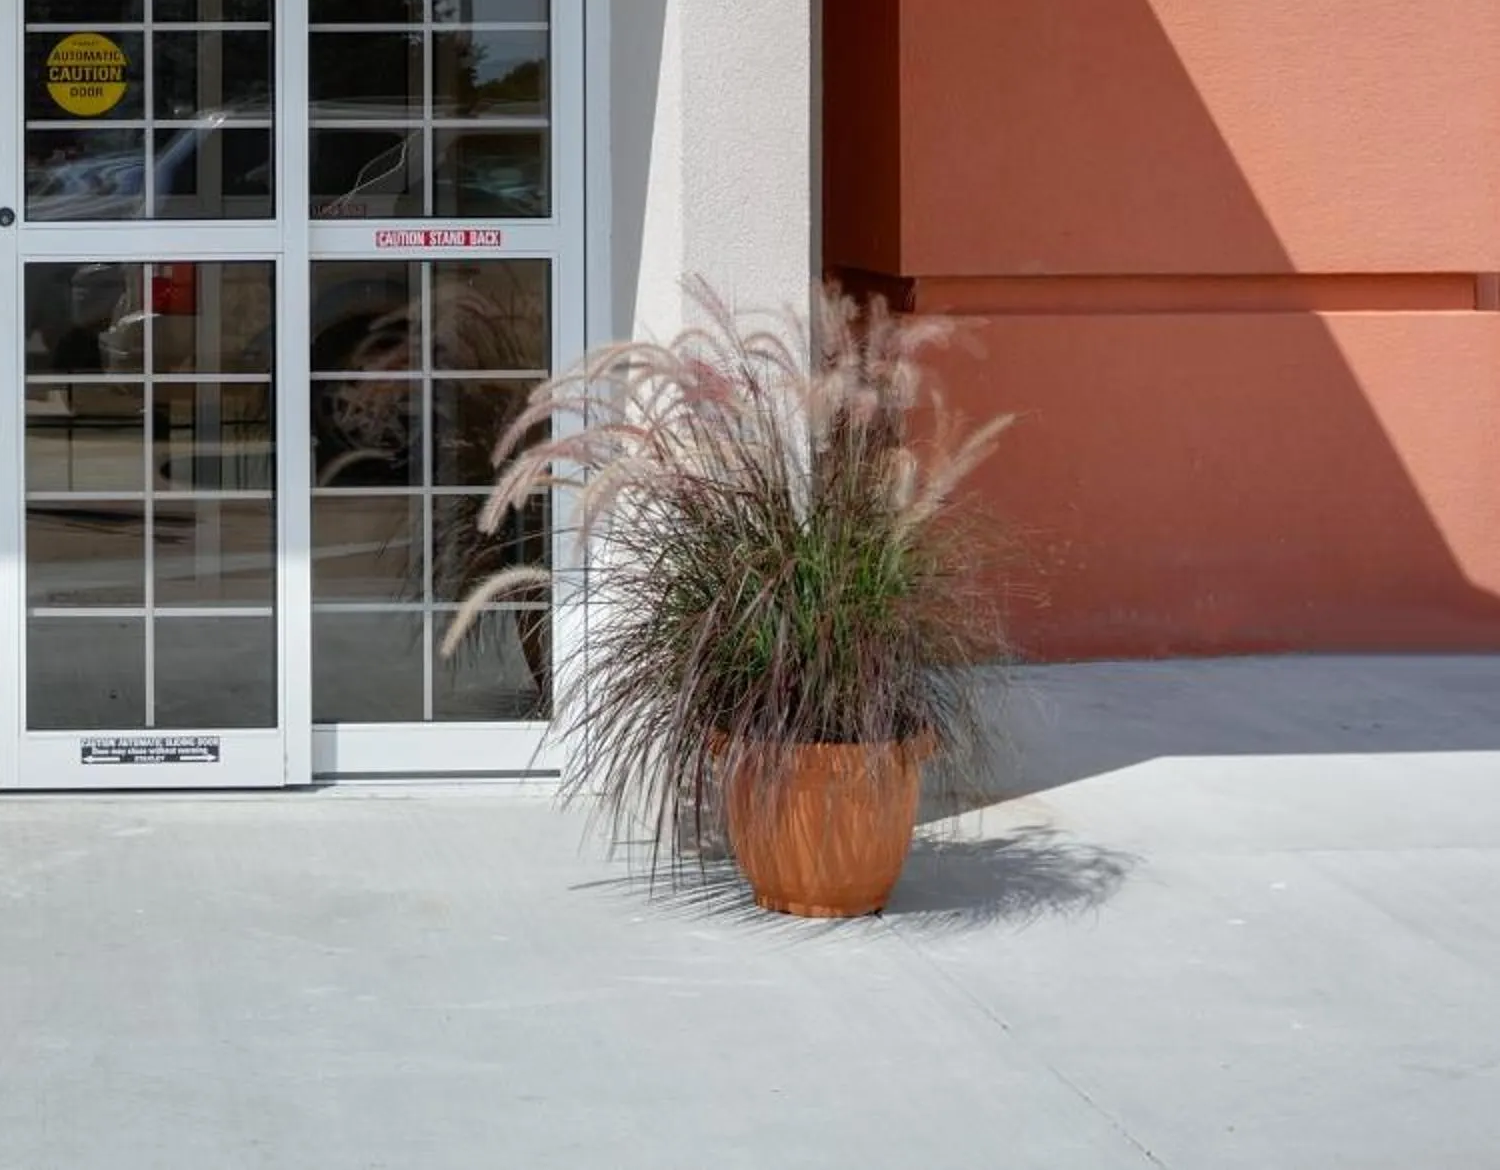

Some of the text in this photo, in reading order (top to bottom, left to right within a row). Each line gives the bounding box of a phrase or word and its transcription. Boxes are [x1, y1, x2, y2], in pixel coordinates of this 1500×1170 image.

[52, 50, 121, 61] AUTOMATIC
[49, 67, 122, 81] CAUTION
[70, 86, 103, 98] DOOR
[380, 231, 499, 246] CAUTION STAND BACK
